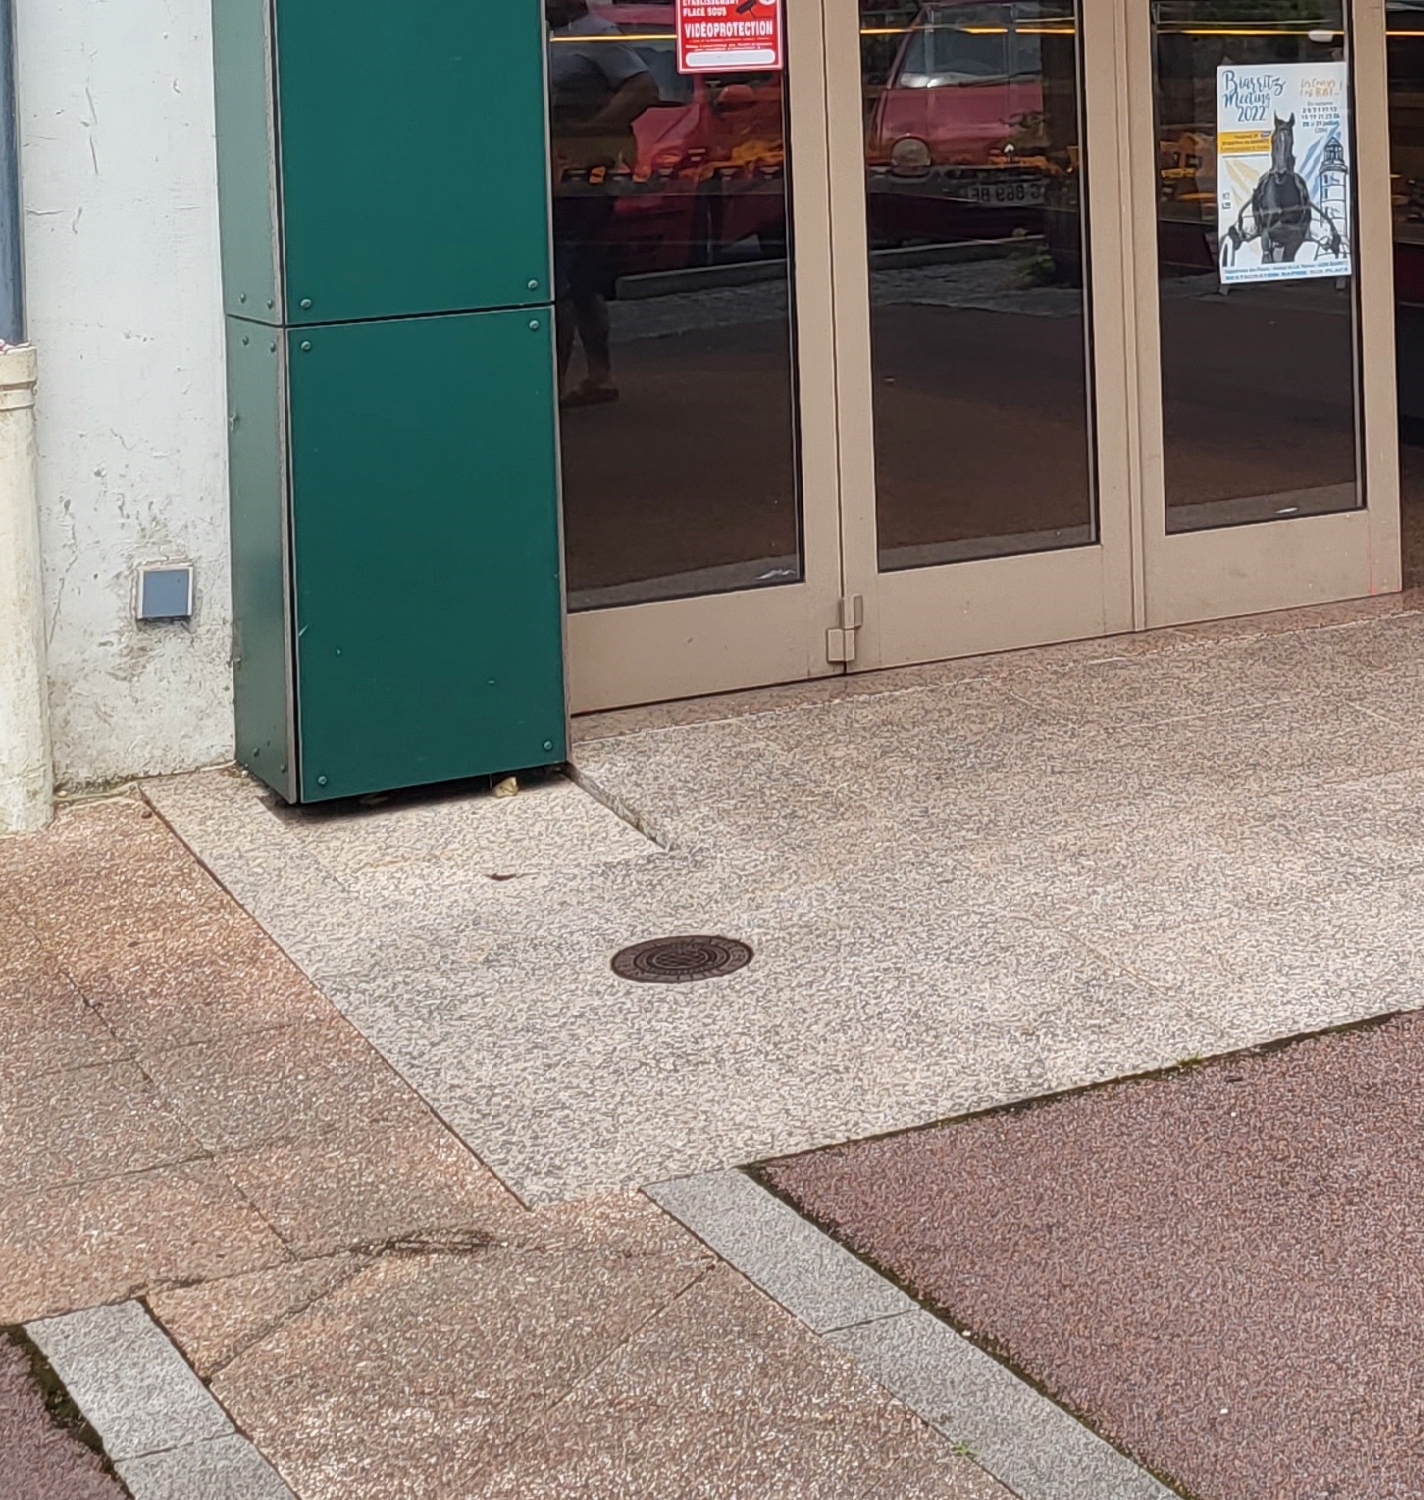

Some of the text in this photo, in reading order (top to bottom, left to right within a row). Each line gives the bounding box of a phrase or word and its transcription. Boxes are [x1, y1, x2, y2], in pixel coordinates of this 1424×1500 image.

[707, 6, 727, 17] SOUS
[684, 19, 773, 38] VIDÉOPROTECTION
[1237, 105, 1267, 122] 2022
